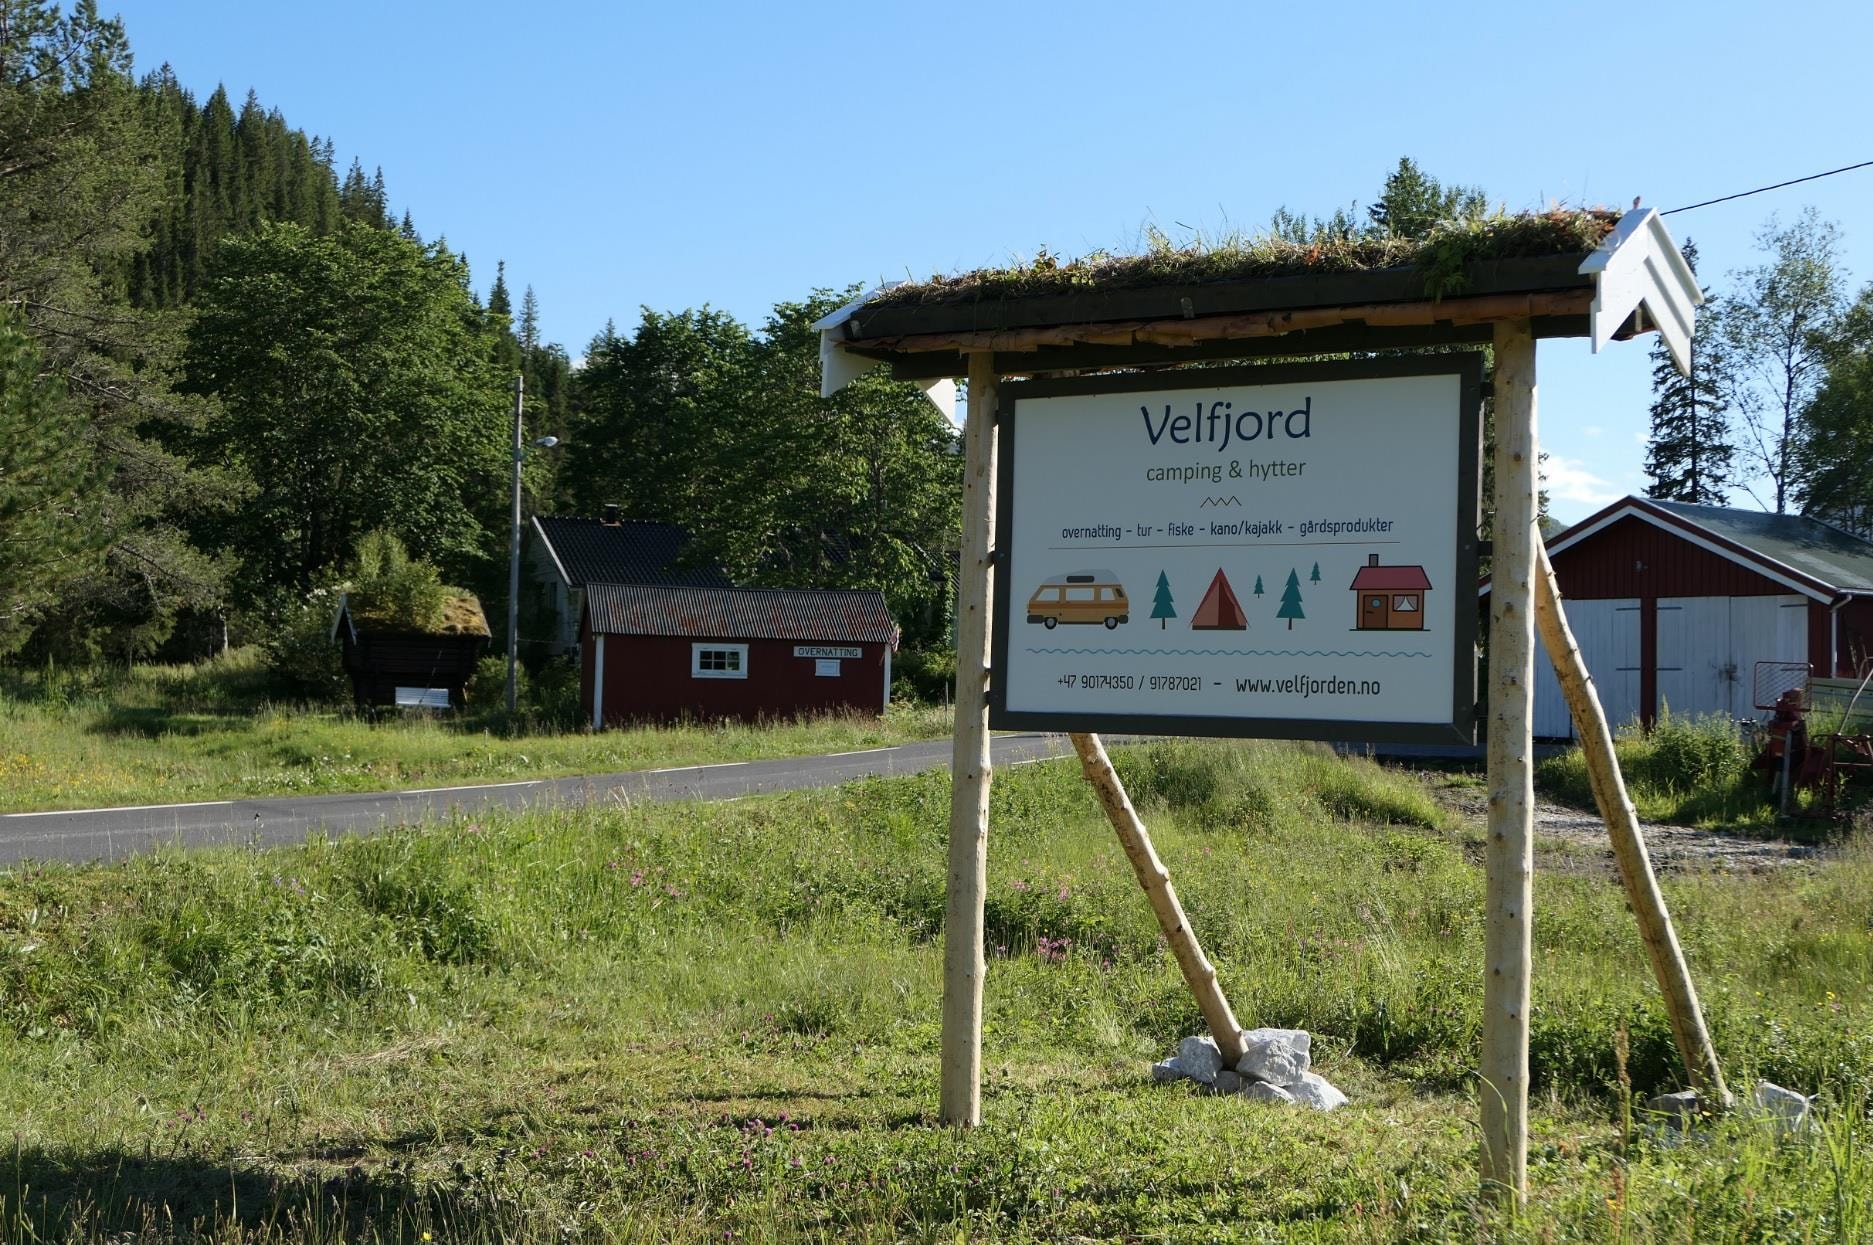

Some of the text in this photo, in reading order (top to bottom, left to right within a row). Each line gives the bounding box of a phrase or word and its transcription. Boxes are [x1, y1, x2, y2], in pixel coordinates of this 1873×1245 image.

[1140, 395, 1312, 453] Velfjord
[1146, 458, 1307, 485] camping & hytter
[1061, 523, 1122, 542] overnatting
[1136, 522, 1153, 537] tur
[1167, 521, 1195, 537] fiske
[1210, 519, 1283, 539] kano/kajakk
[1299, 516, 1394, 538] gårdsprodukter
[798, 647, 858, 657] OVERNATTING
[1057, 674, 1077, 689] +47
[1080, 674, 1134, 690] 90174350
[1138, 674, 1145, 691] /
[1149, 675, 1202, 691] 91787021
[1235, 674, 1381, 699] www.velfjorden.no
